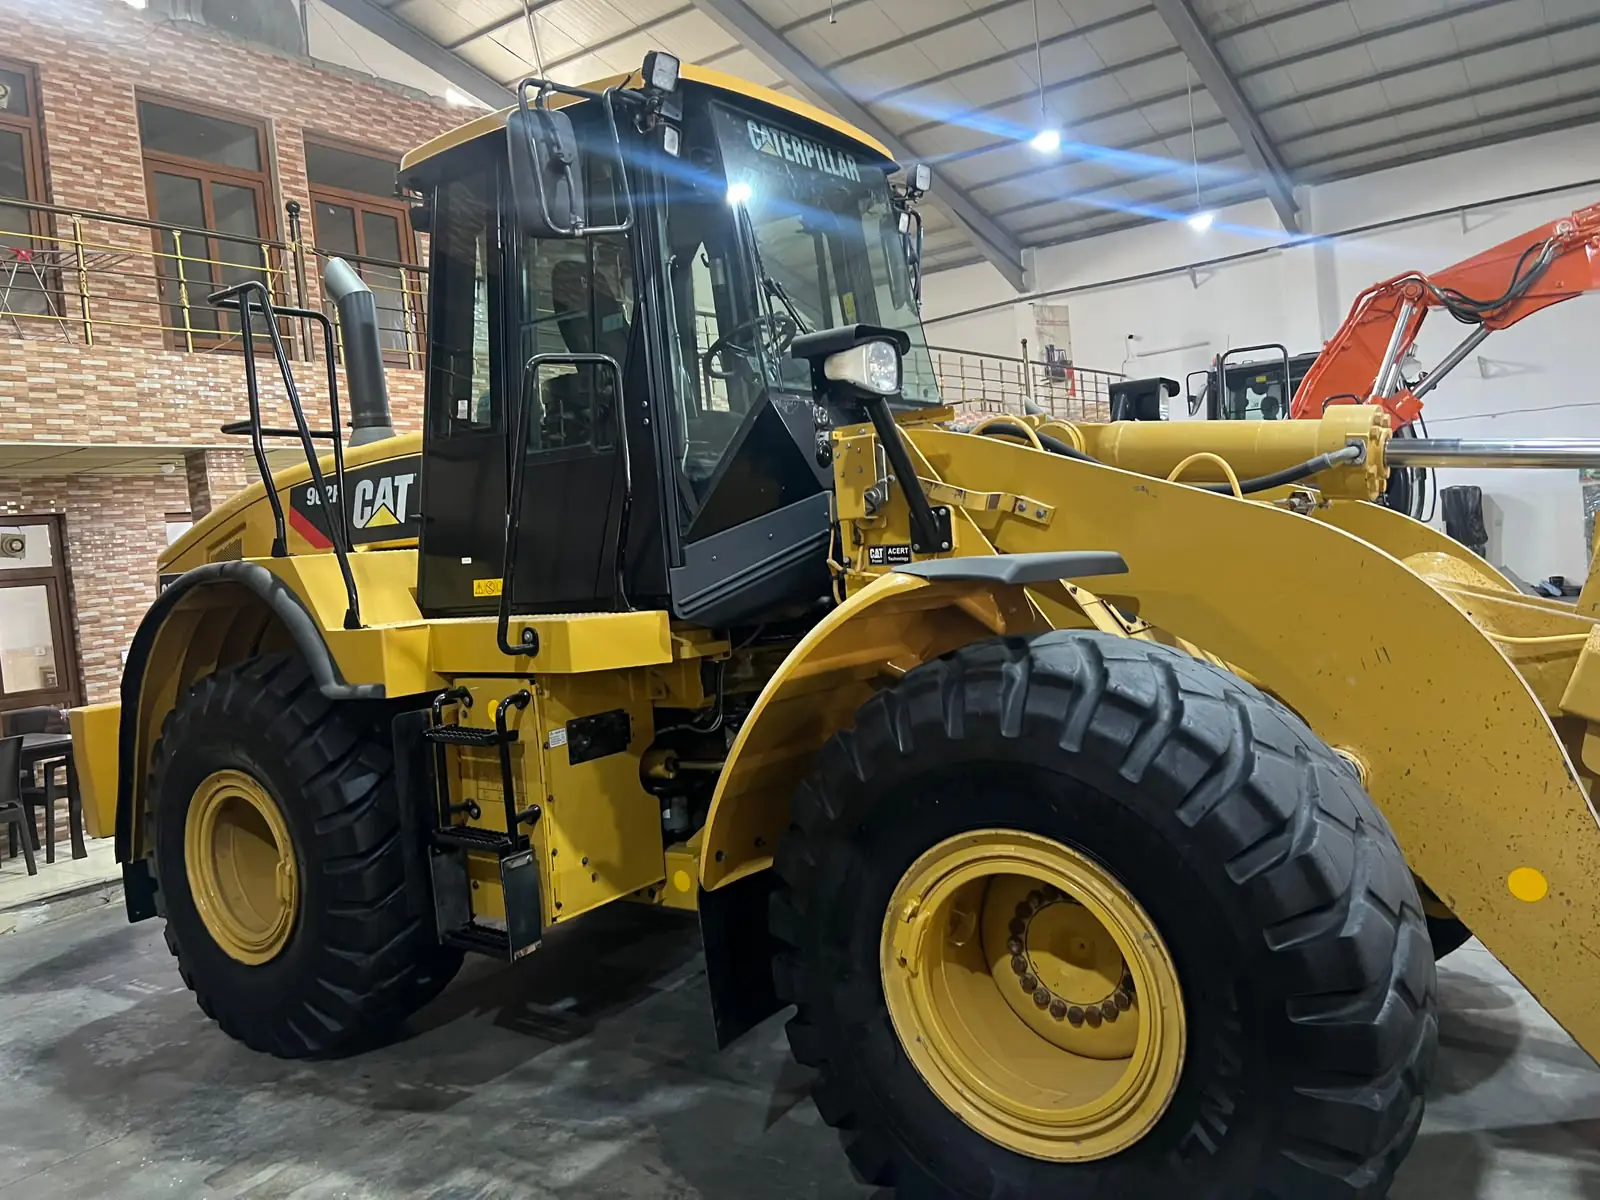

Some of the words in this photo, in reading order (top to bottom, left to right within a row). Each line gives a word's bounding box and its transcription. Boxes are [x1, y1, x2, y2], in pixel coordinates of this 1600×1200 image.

[746, 119, 861, 183] CATERPILLAR
[353, 474, 414, 529] CAT
[869, 548, 883, 558] CAT
[887, 547, 909, 555] ACERT
